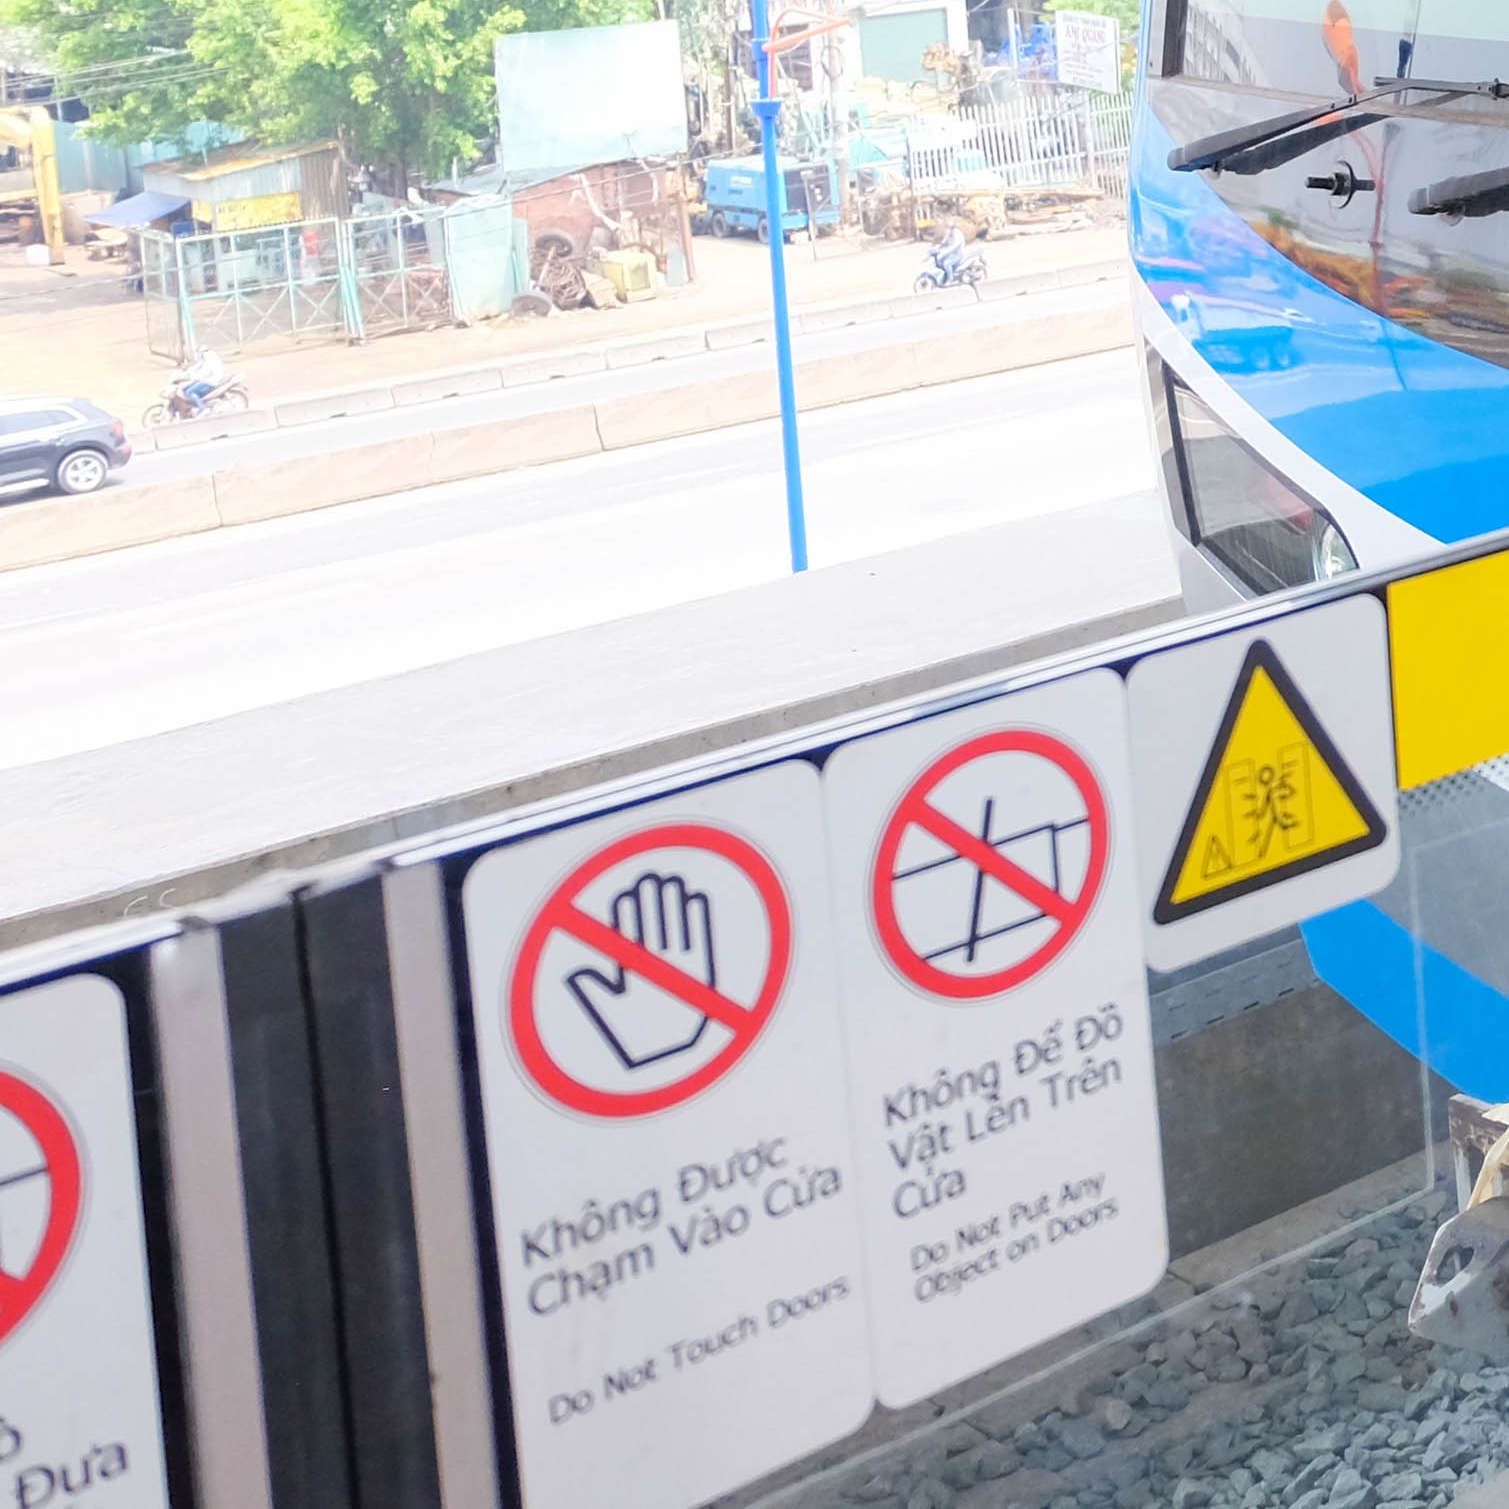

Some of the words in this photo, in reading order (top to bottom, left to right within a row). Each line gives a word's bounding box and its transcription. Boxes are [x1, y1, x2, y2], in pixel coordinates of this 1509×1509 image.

[883, 1060, 1001, 1127] Không
[965, 1092, 1030, 1142] Lên
[1040, 1057, 1122, 1108] Trên
[521, 1187, 662, 1267] Không
[527, 1242, 655, 1316] Chạm
[668, 1204, 750, 1256] Vào
[910, 1241, 949, 1271] Do
[954, 1216, 1001, 1251] Not
[1008, 1193, 1050, 1229] Put
[1058, 1172, 1106, 1208] Any
[913, 1248, 1001, 1303] Object
[1005, 1232, 1040, 1262] on
[1047, 1196, 1119, 1244] Doors
[549, 1389, 595, 1424] Do
[602, 1358, 657, 1399] Not
[668, 1315, 759, 1369] Touch
[766, 1274, 851, 1329] Doors
